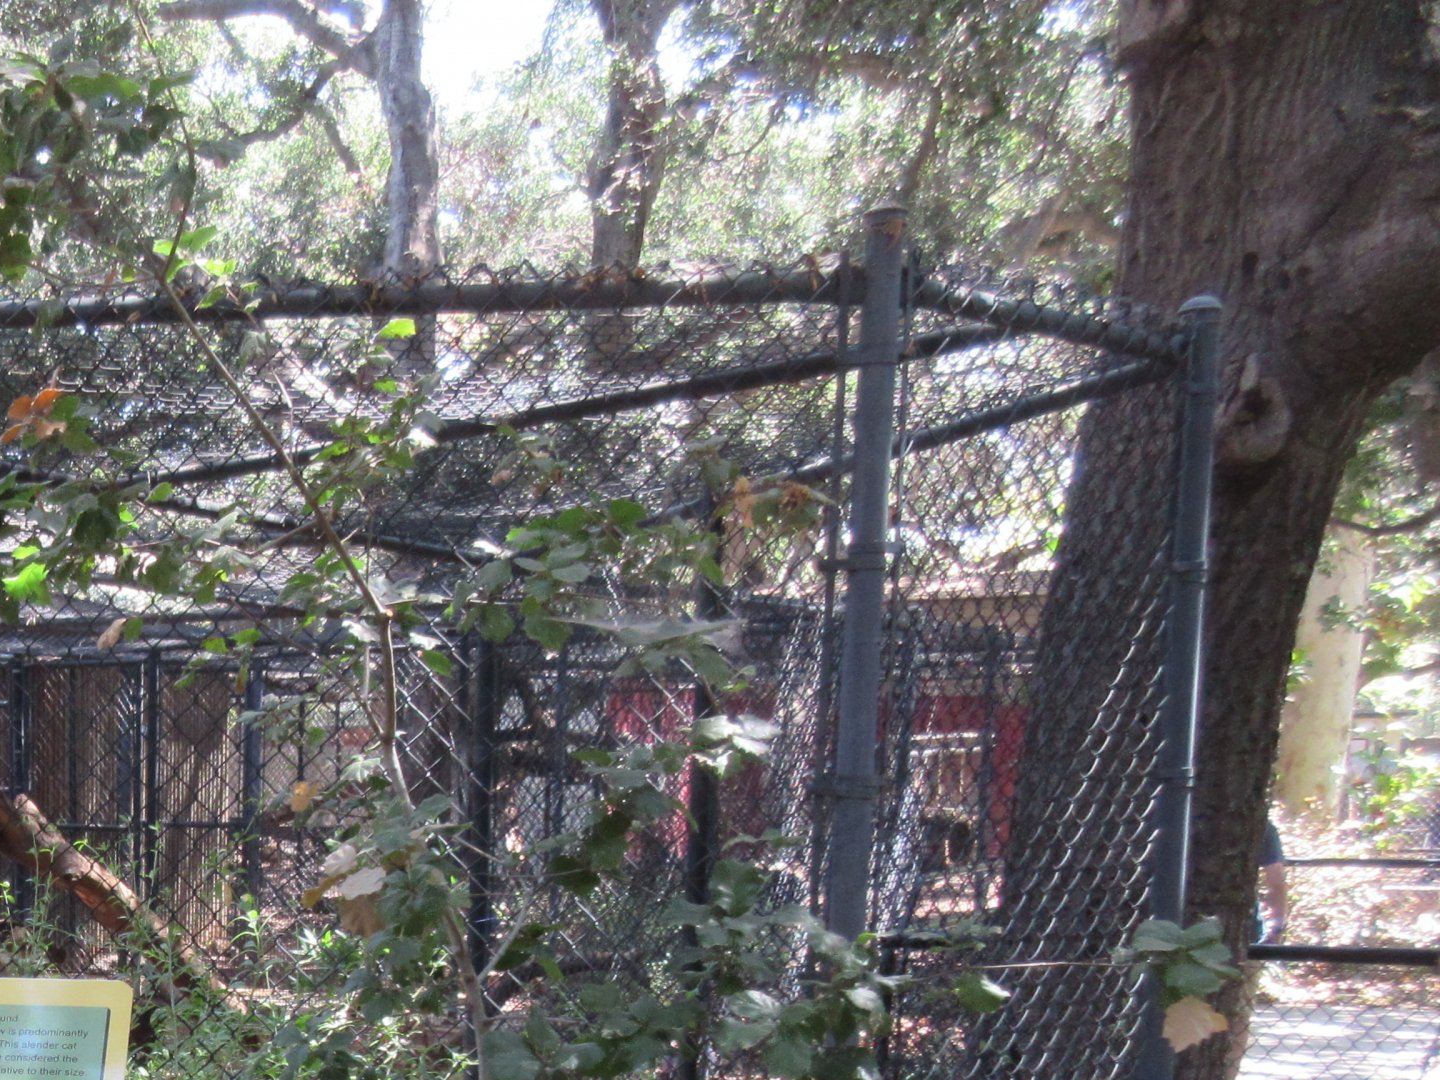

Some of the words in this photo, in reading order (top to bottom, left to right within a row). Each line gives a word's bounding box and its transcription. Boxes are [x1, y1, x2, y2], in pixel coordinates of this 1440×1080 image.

[61, 1041, 77, 1049] cat
[62, 1054, 78, 1063] the
[26, 1066, 37, 1075] to
[39, 1066, 62, 1075] their
